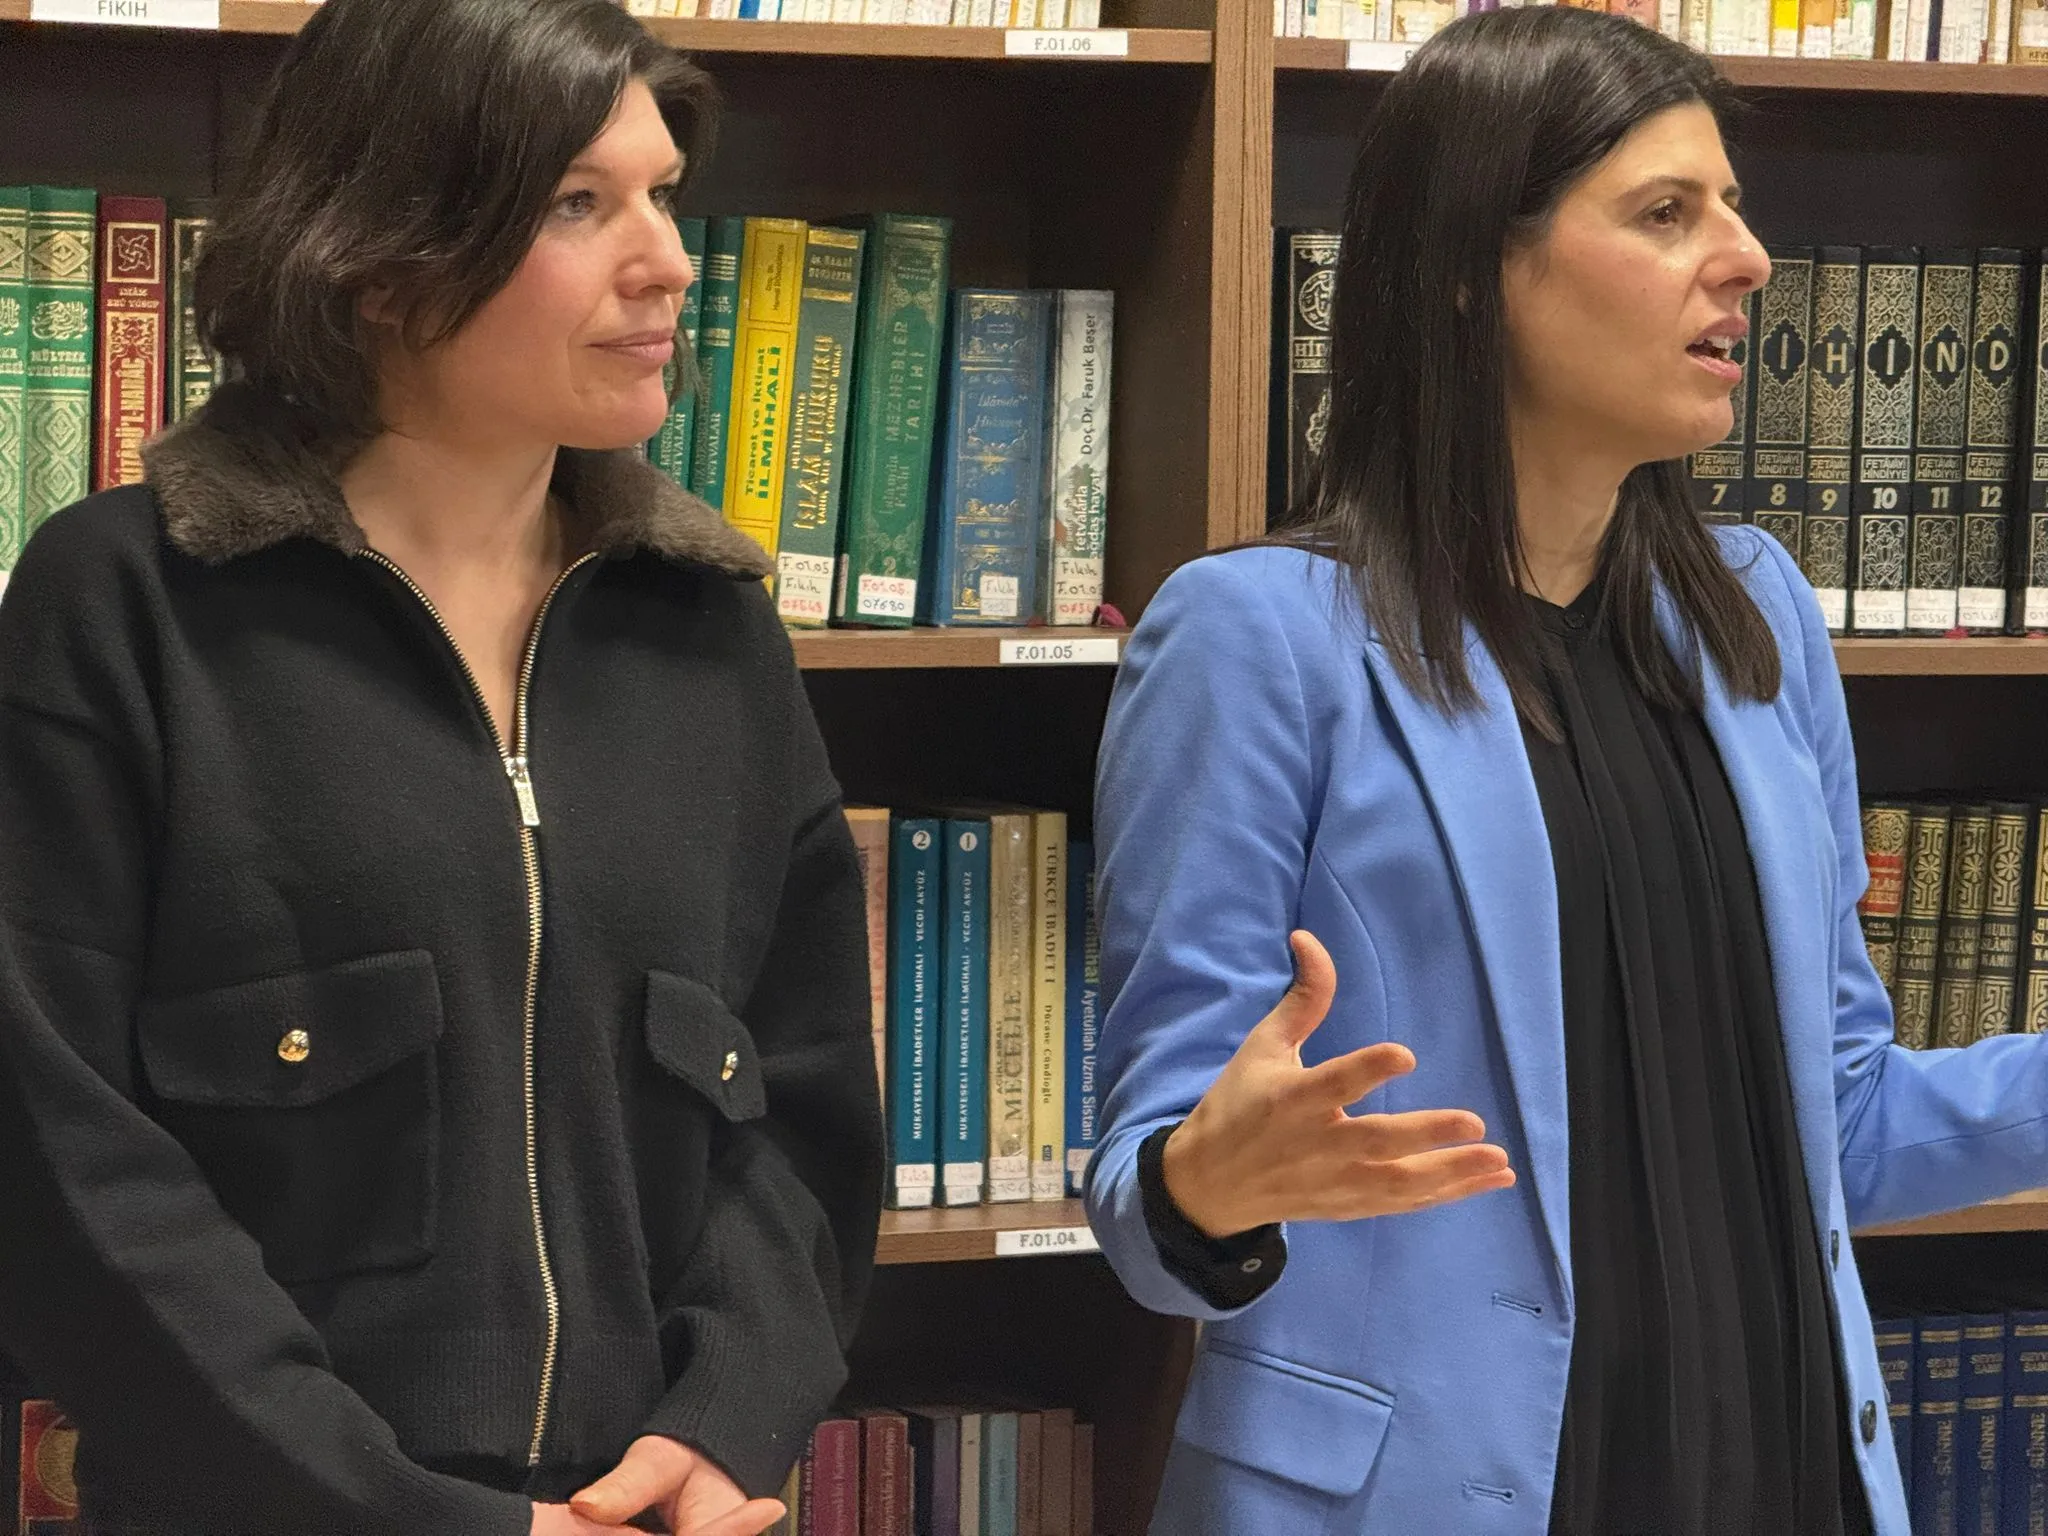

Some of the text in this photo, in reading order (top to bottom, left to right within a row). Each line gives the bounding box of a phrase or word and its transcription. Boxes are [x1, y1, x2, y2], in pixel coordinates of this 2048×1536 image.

[1033, 37, 1092, 52] F.01.06
[1826, 342, 1848, 374] H
[1936, 341, 1958, 373] N
[1989, 340, 2010, 371] D
[886, 321, 908, 442] MEZHEBLER
[1081, 358, 1094, 399] Faruk
[904, 352, 925, 443] TARİHİ
[755, 345, 782, 499] İLMİHALİ
[746, 435, 757, 496] Ticaret
[753, 409, 760, 429] ve
[1711, 484, 1728, 505] 7
[1770, 483, 1786, 506] 8
[1821, 488, 1838, 511] 9
[1872, 487, 1898, 509] 10
[1931, 487, 1949, 508] 11
[1980, 486, 2004, 508] 12
[1074, 485, 1089, 552] fetvalarla
[883, 556, 897, 576] 2
[1015, 645, 1073, 660] F.01.05
[916, 833, 927, 847] 2
[1004, 989, 1022, 1121] MECELLE
[1082, 989, 1097, 1141] Ayetullah Uzma Sistani
[1019, 1233, 1077, 1248] F.01.04
